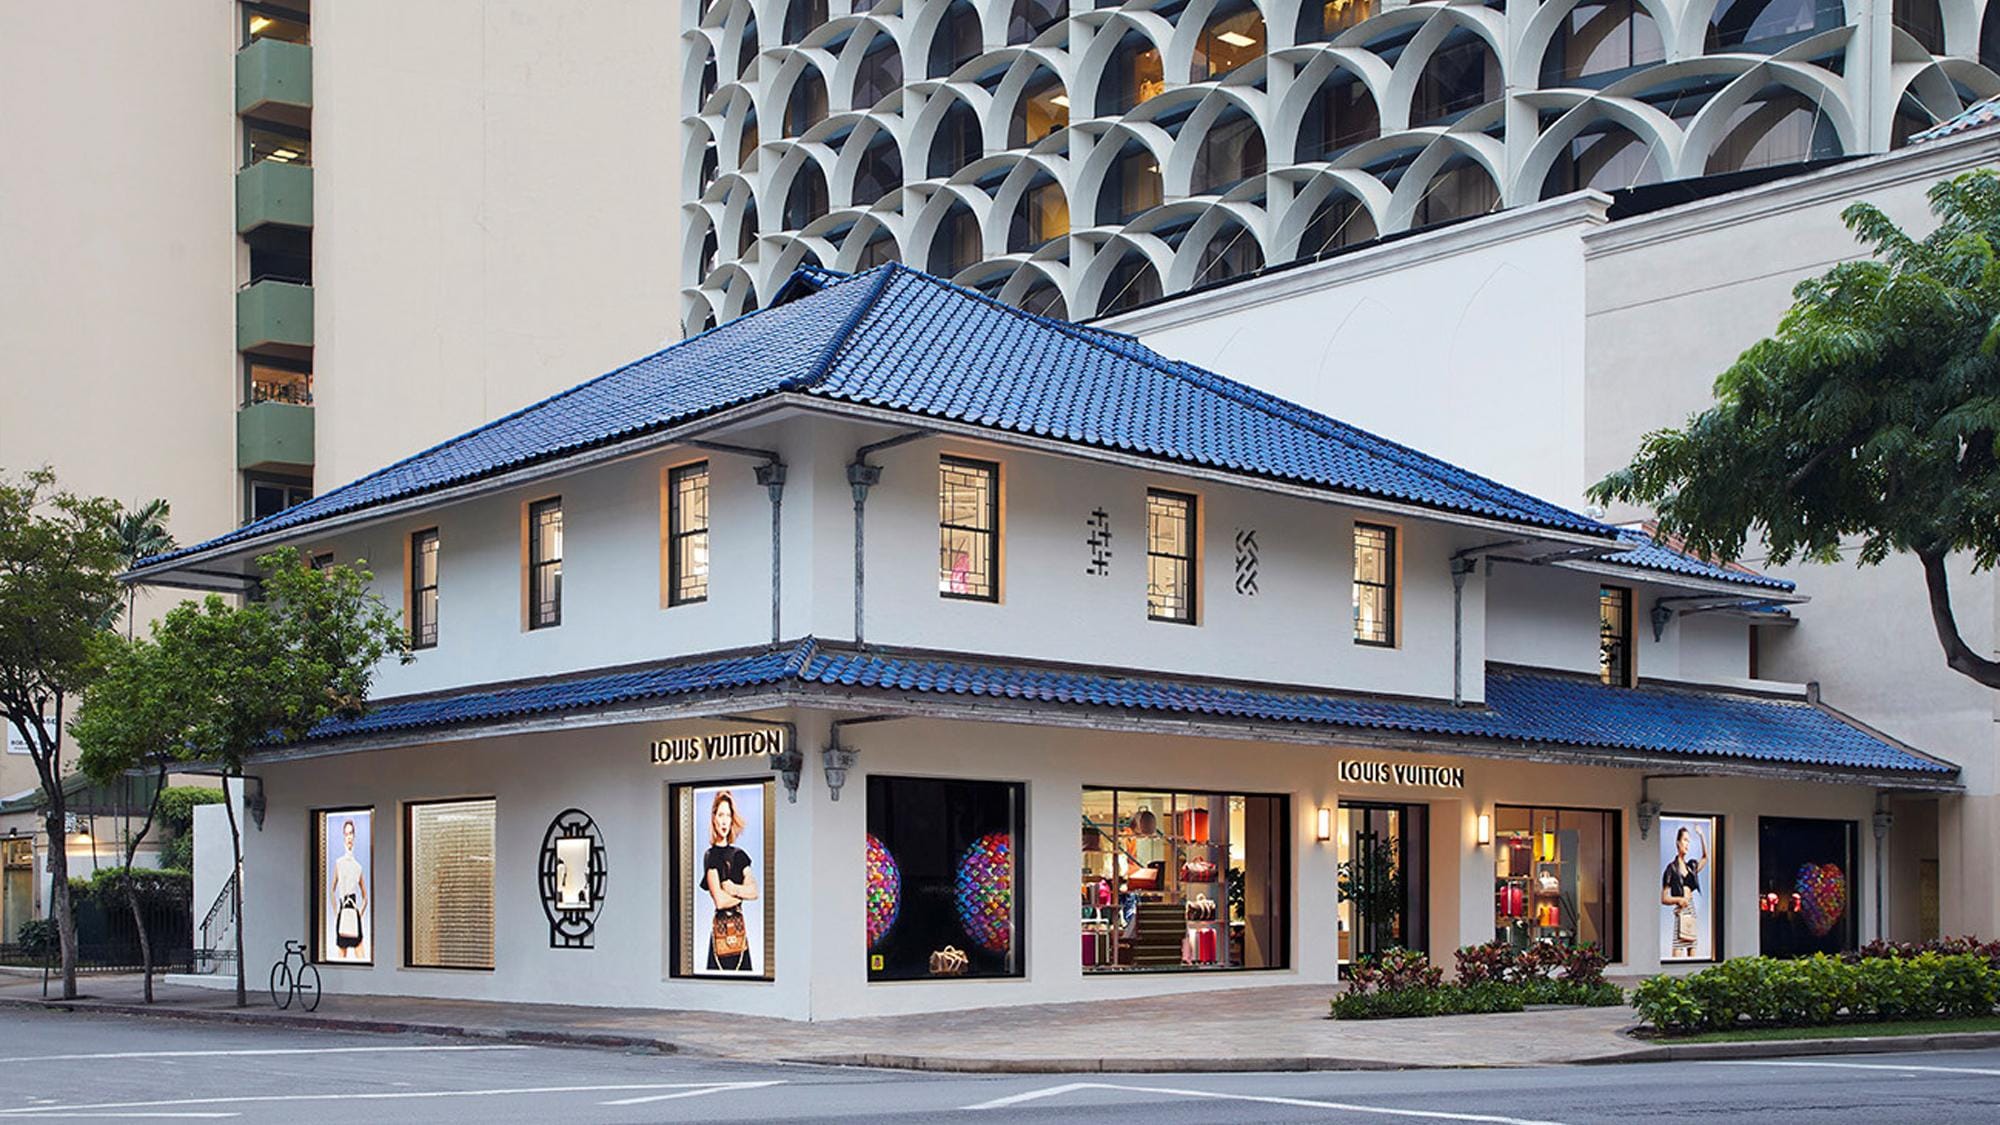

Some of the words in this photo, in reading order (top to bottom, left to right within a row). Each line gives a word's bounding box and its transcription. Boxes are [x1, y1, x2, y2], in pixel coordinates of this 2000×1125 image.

[650, 738, 700, 763] LOUIS
[703, 729, 781, 760] VUITTON
[1339, 761, 1390, 783] LOUIS
[1394, 764, 1464, 788] VUITTON
